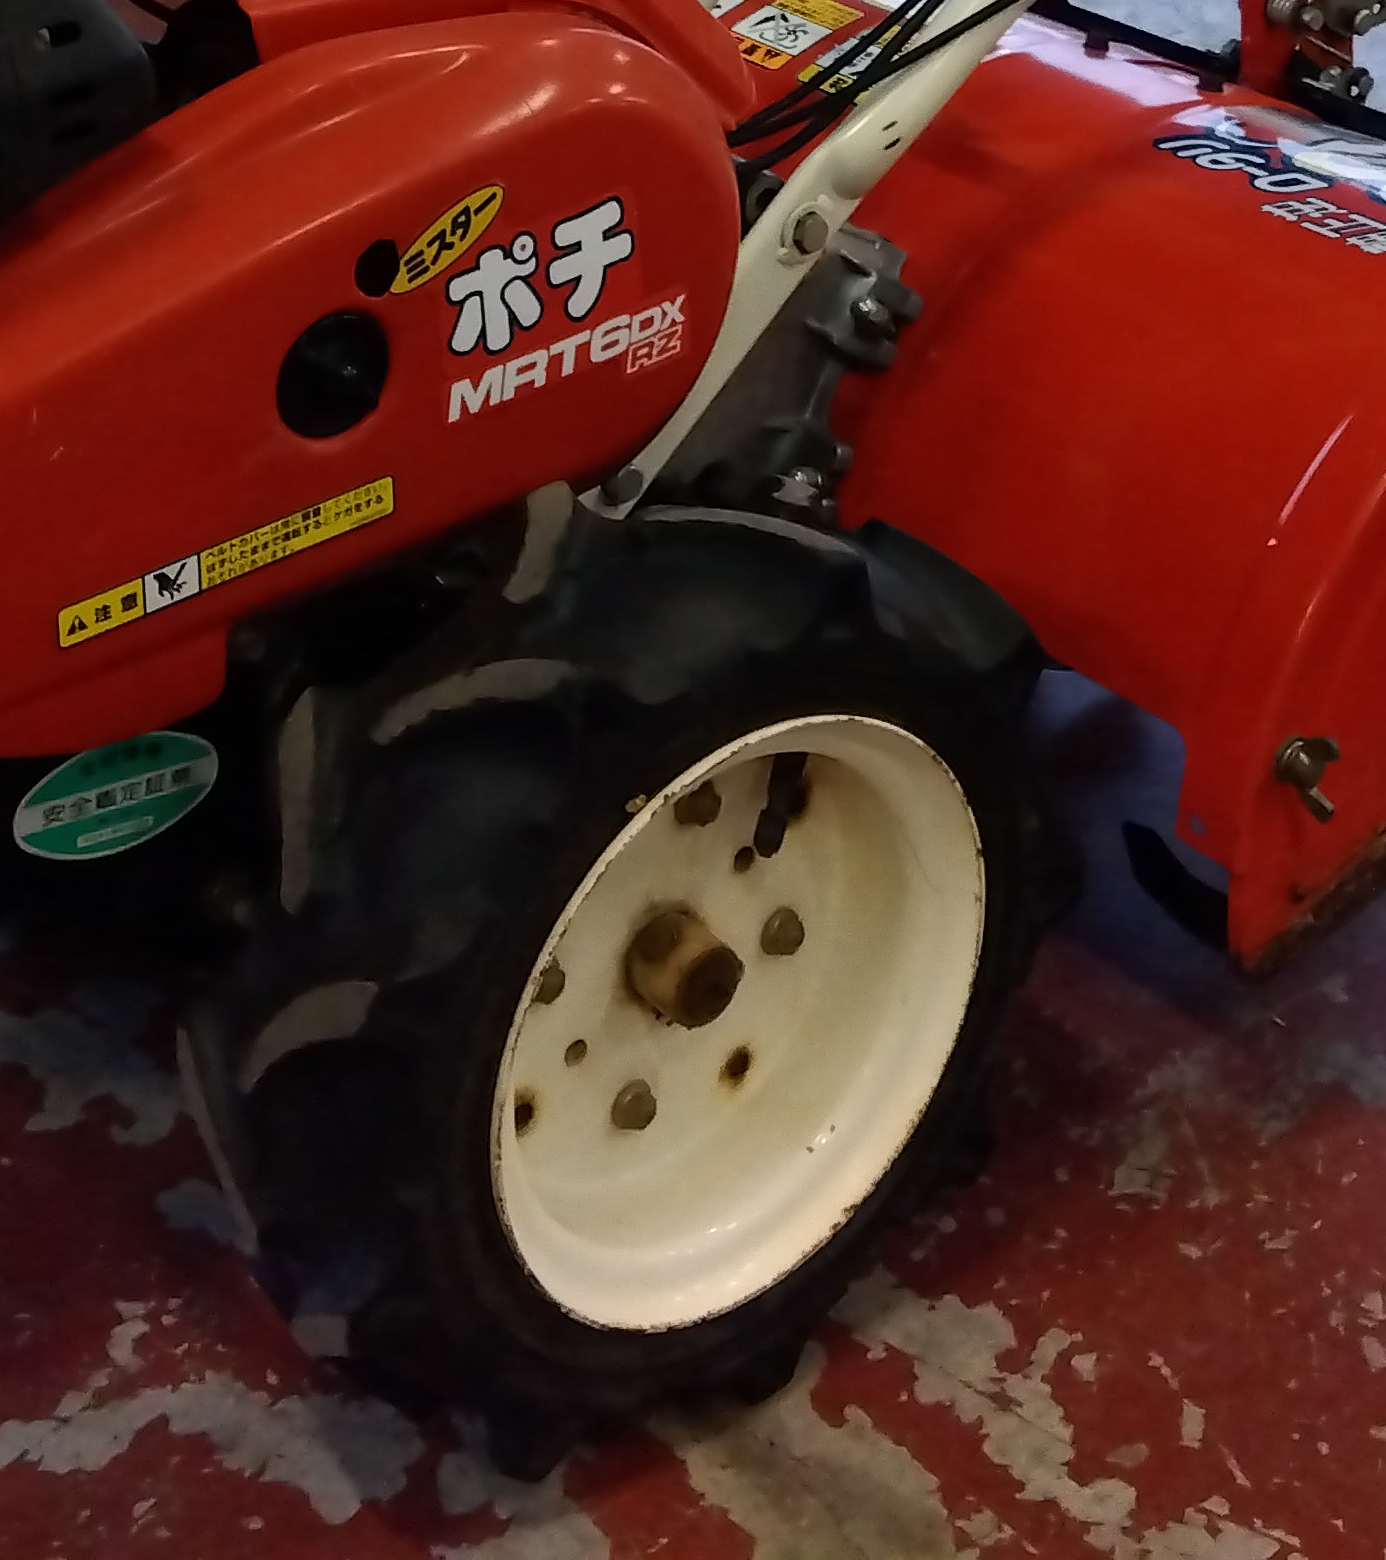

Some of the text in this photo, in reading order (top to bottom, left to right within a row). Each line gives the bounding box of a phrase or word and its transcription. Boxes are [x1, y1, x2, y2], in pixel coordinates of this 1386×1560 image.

[402, 190, 499, 286] ミスター
[446, 197, 633, 355] ポチ
[626, 325, 683, 376] RZ
